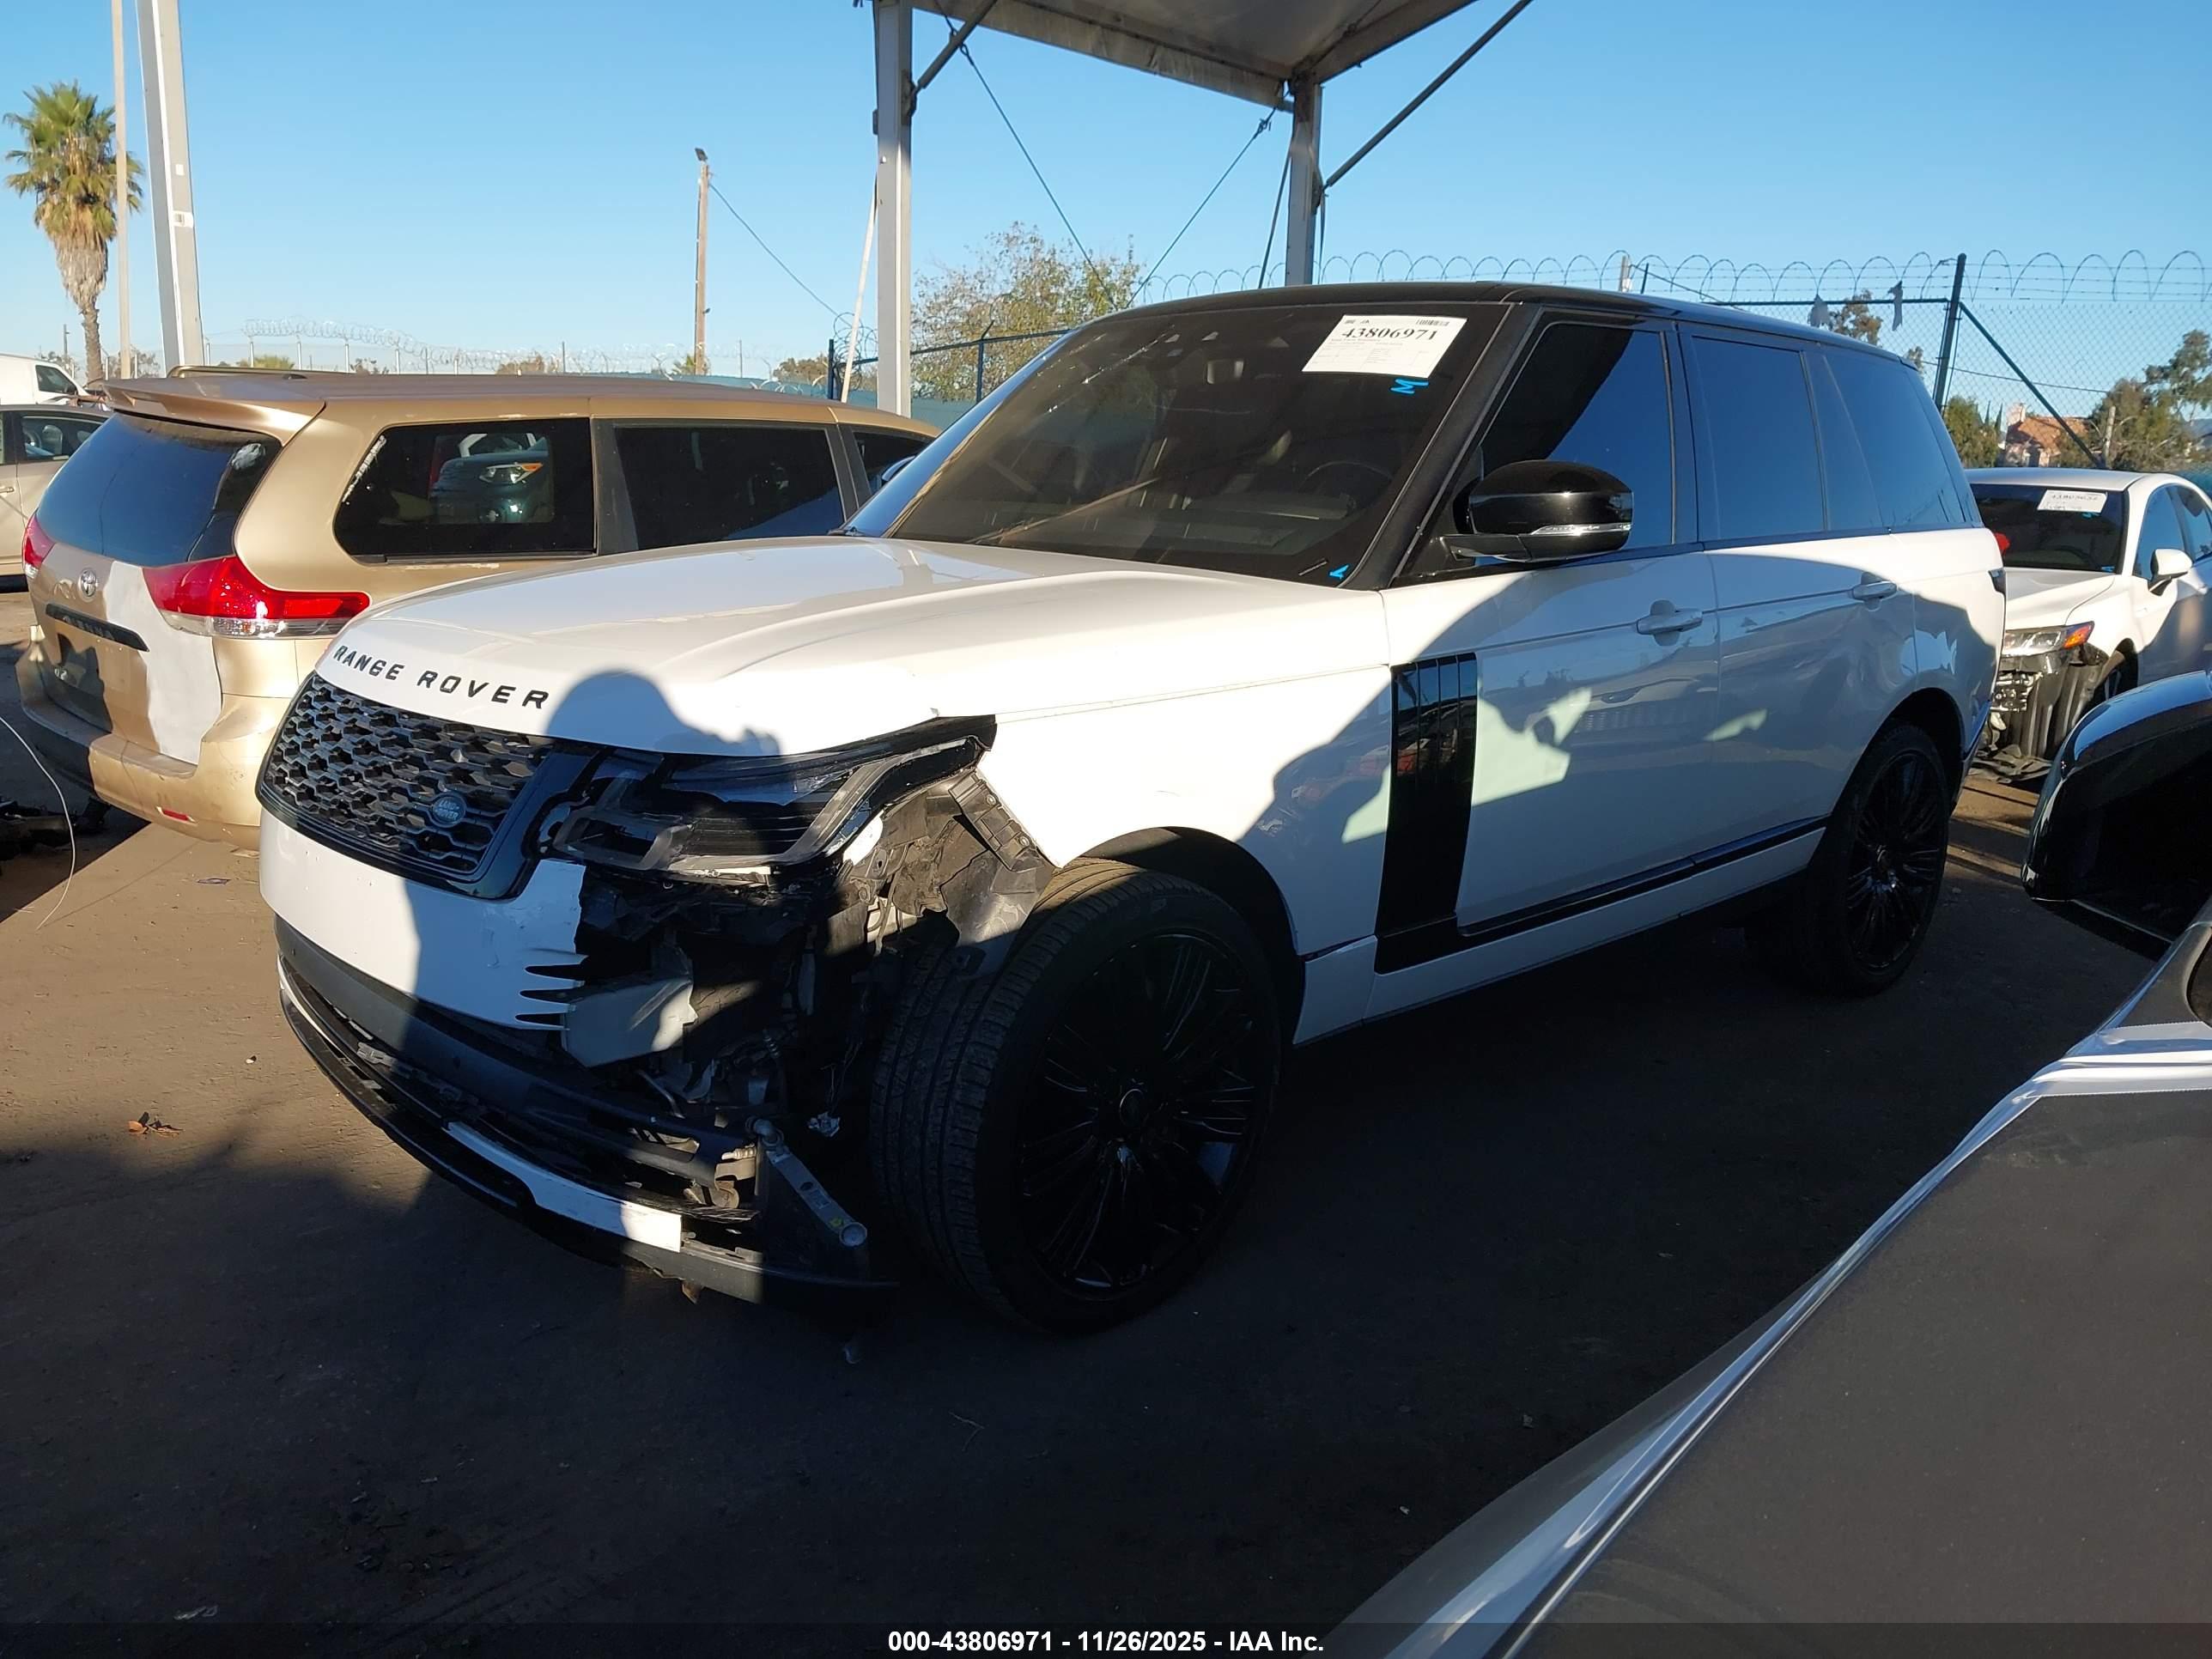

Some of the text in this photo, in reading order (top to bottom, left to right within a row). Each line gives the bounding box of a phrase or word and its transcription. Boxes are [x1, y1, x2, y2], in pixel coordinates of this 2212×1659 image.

[1341, 326, 1437, 340] 43806971
[333, 645, 549, 708] RANGE ROVER
